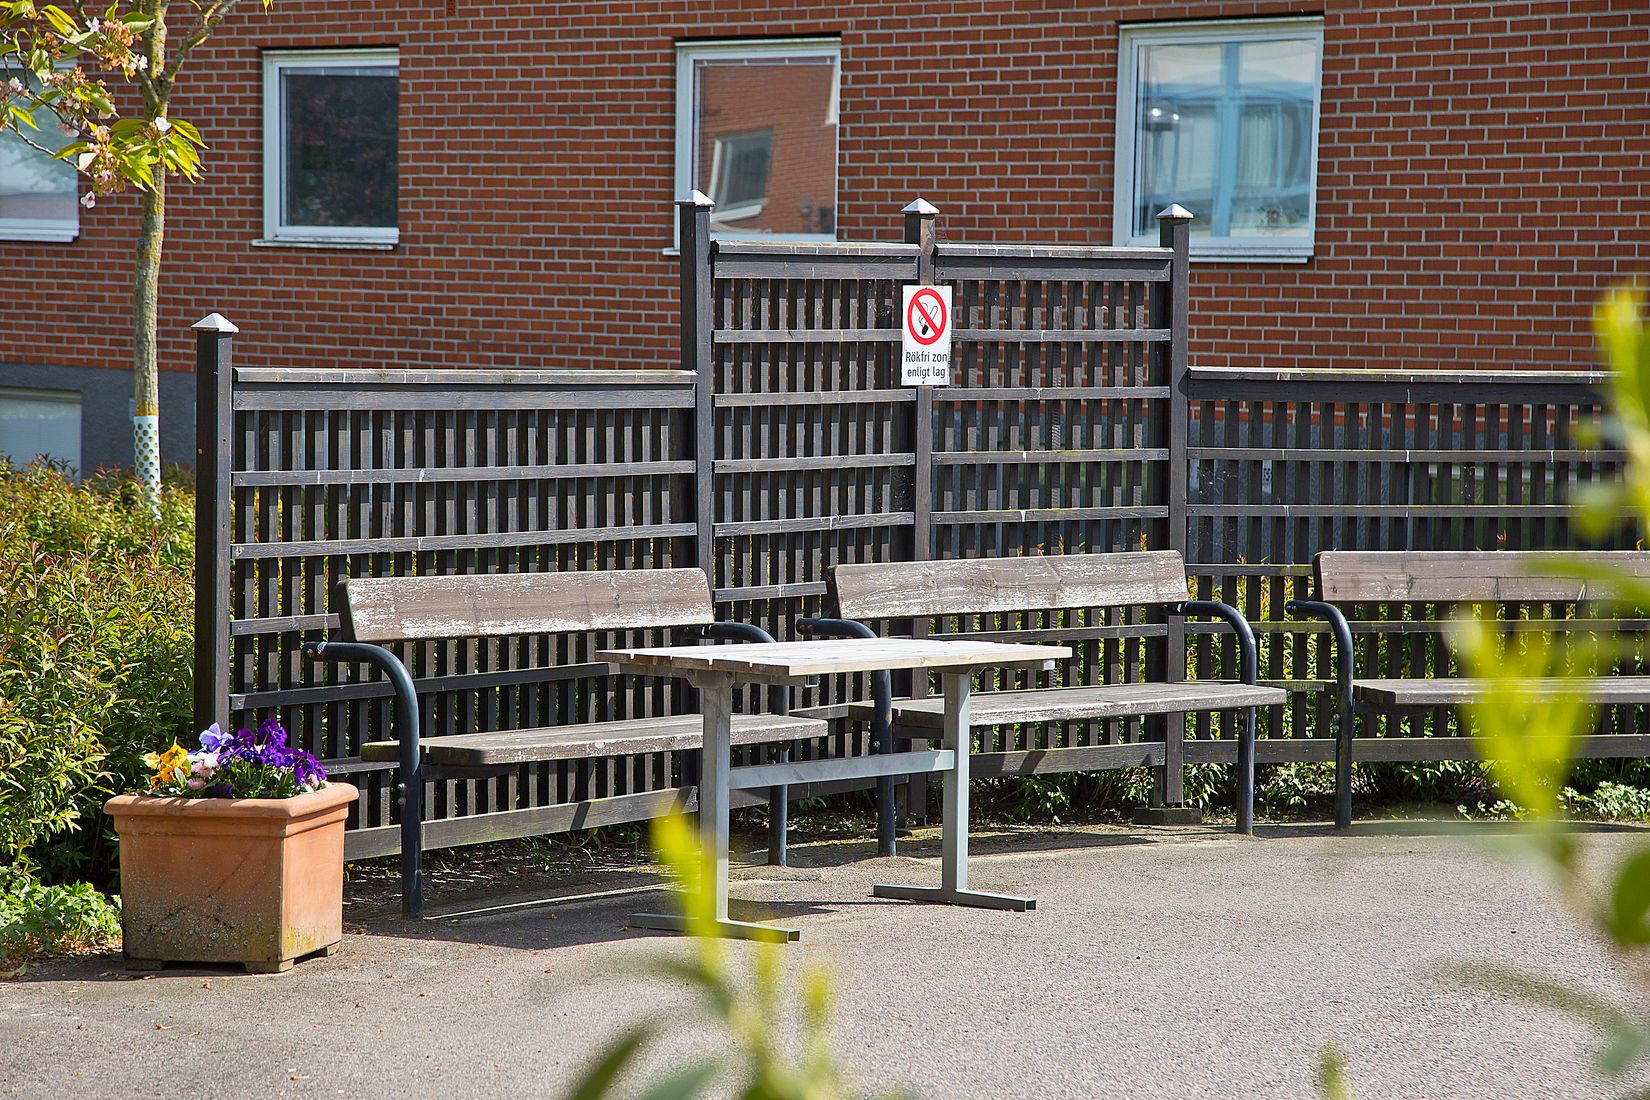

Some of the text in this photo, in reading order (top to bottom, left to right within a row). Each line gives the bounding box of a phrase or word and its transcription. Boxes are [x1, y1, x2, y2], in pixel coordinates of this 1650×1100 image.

[905, 351, 948, 362] Rökfri zon
[907, 366, 946, 379] enligt lag
